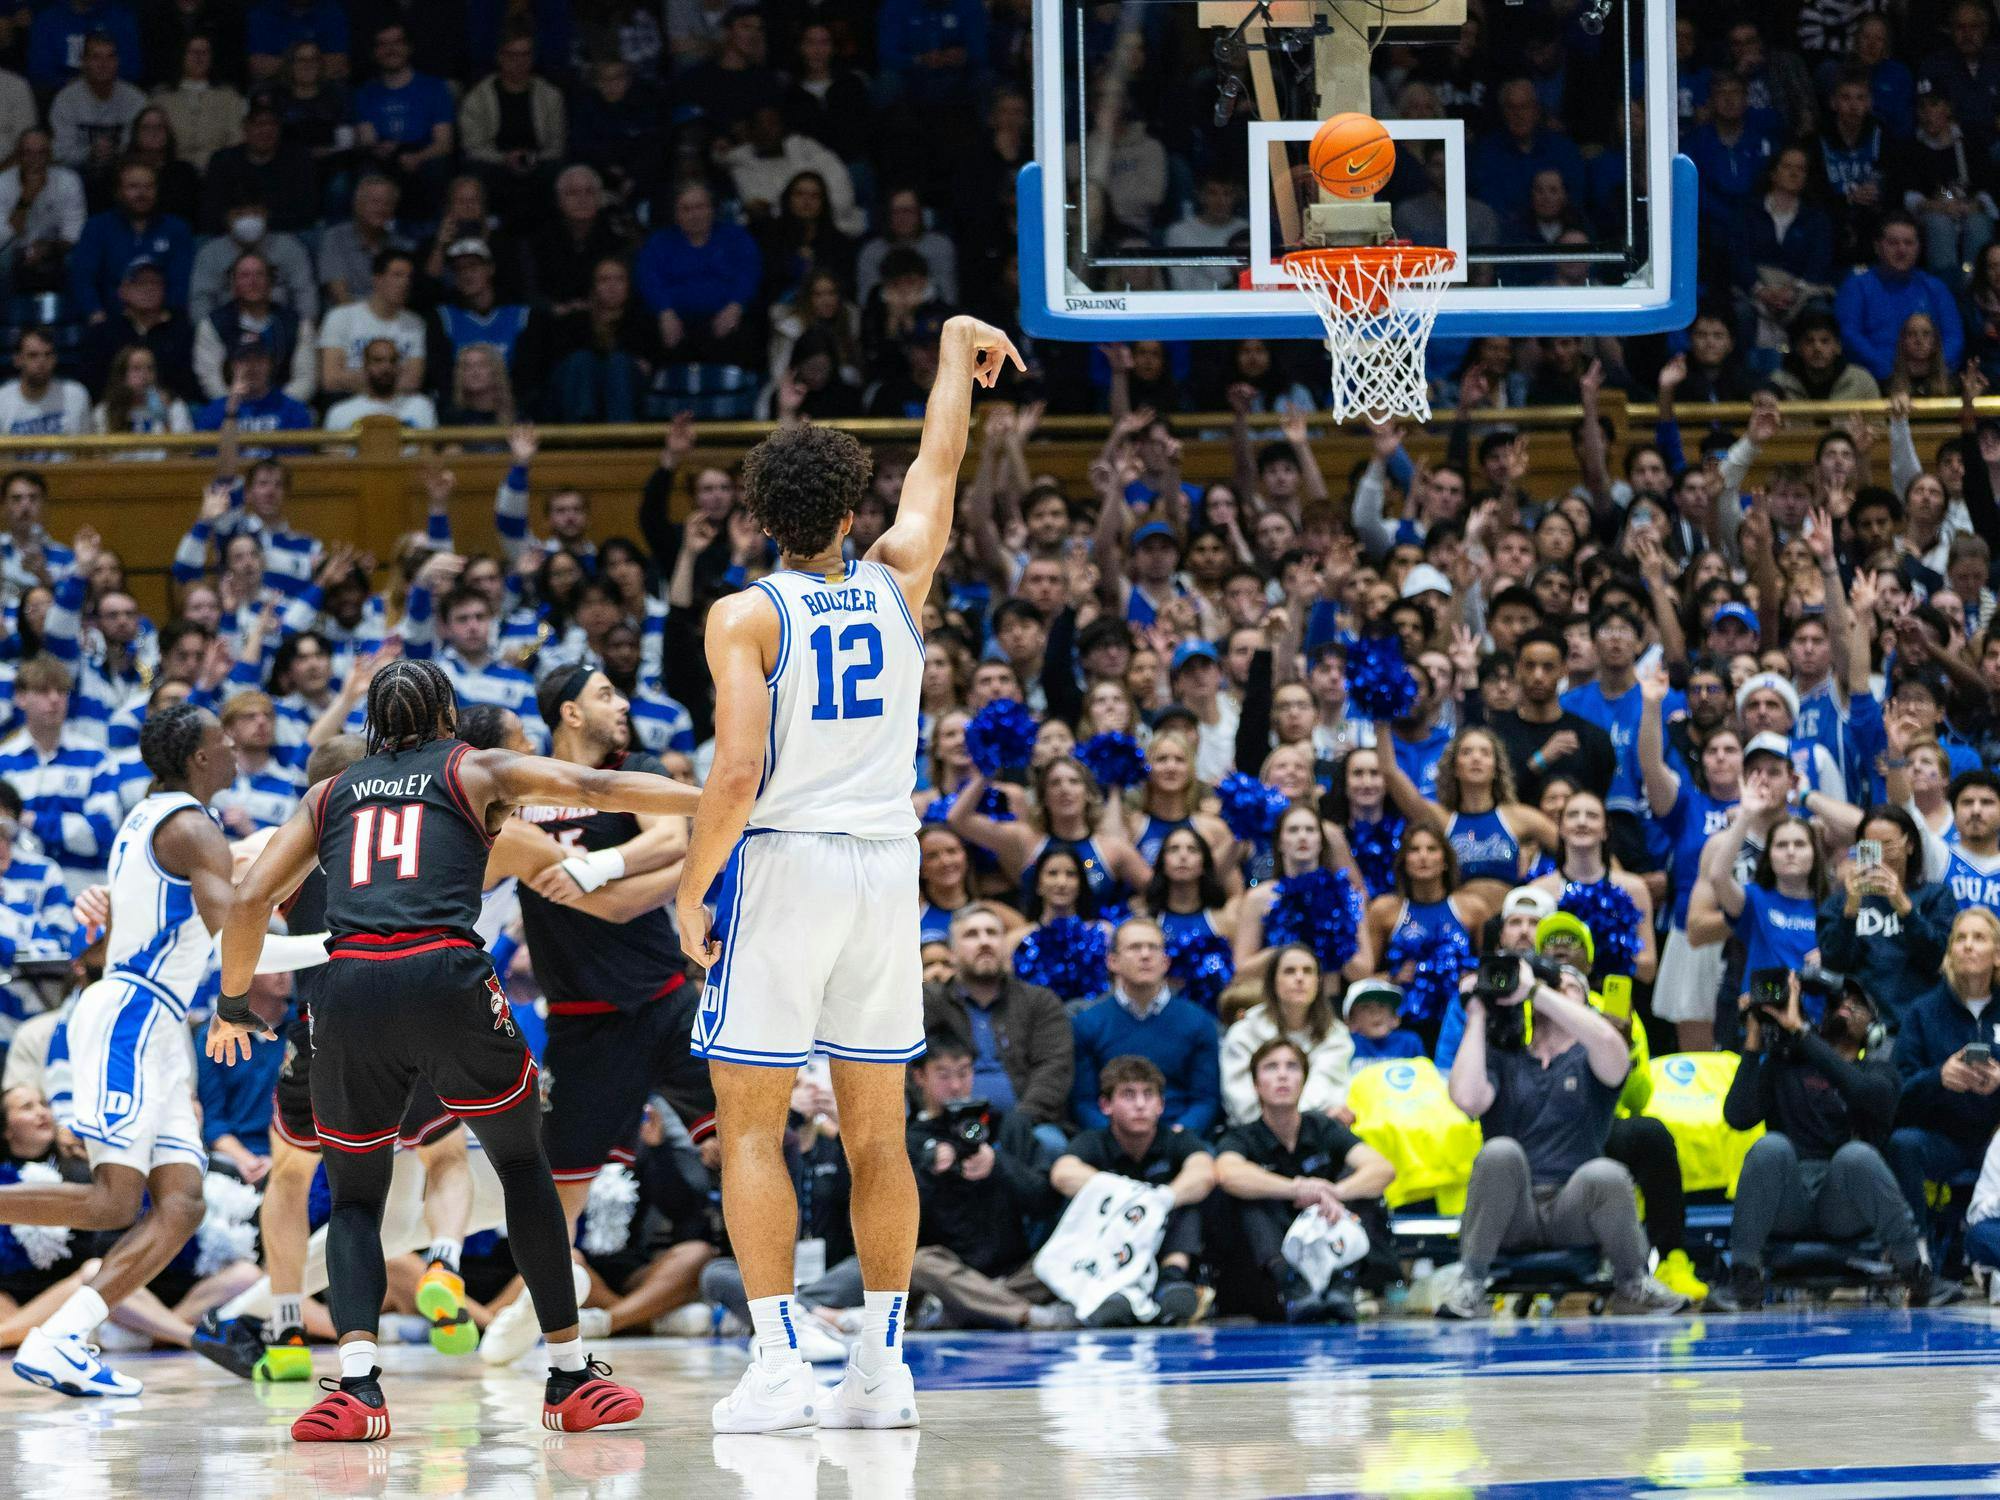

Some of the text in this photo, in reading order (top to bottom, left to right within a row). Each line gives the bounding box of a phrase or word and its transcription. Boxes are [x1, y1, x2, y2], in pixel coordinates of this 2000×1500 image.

[1065, 298, 1127, 312] SPALDING
[810, 622, 884, 720] 12
[351, 774, 432, 801] WOOLEY
[350, 803, 424, 889] 14
